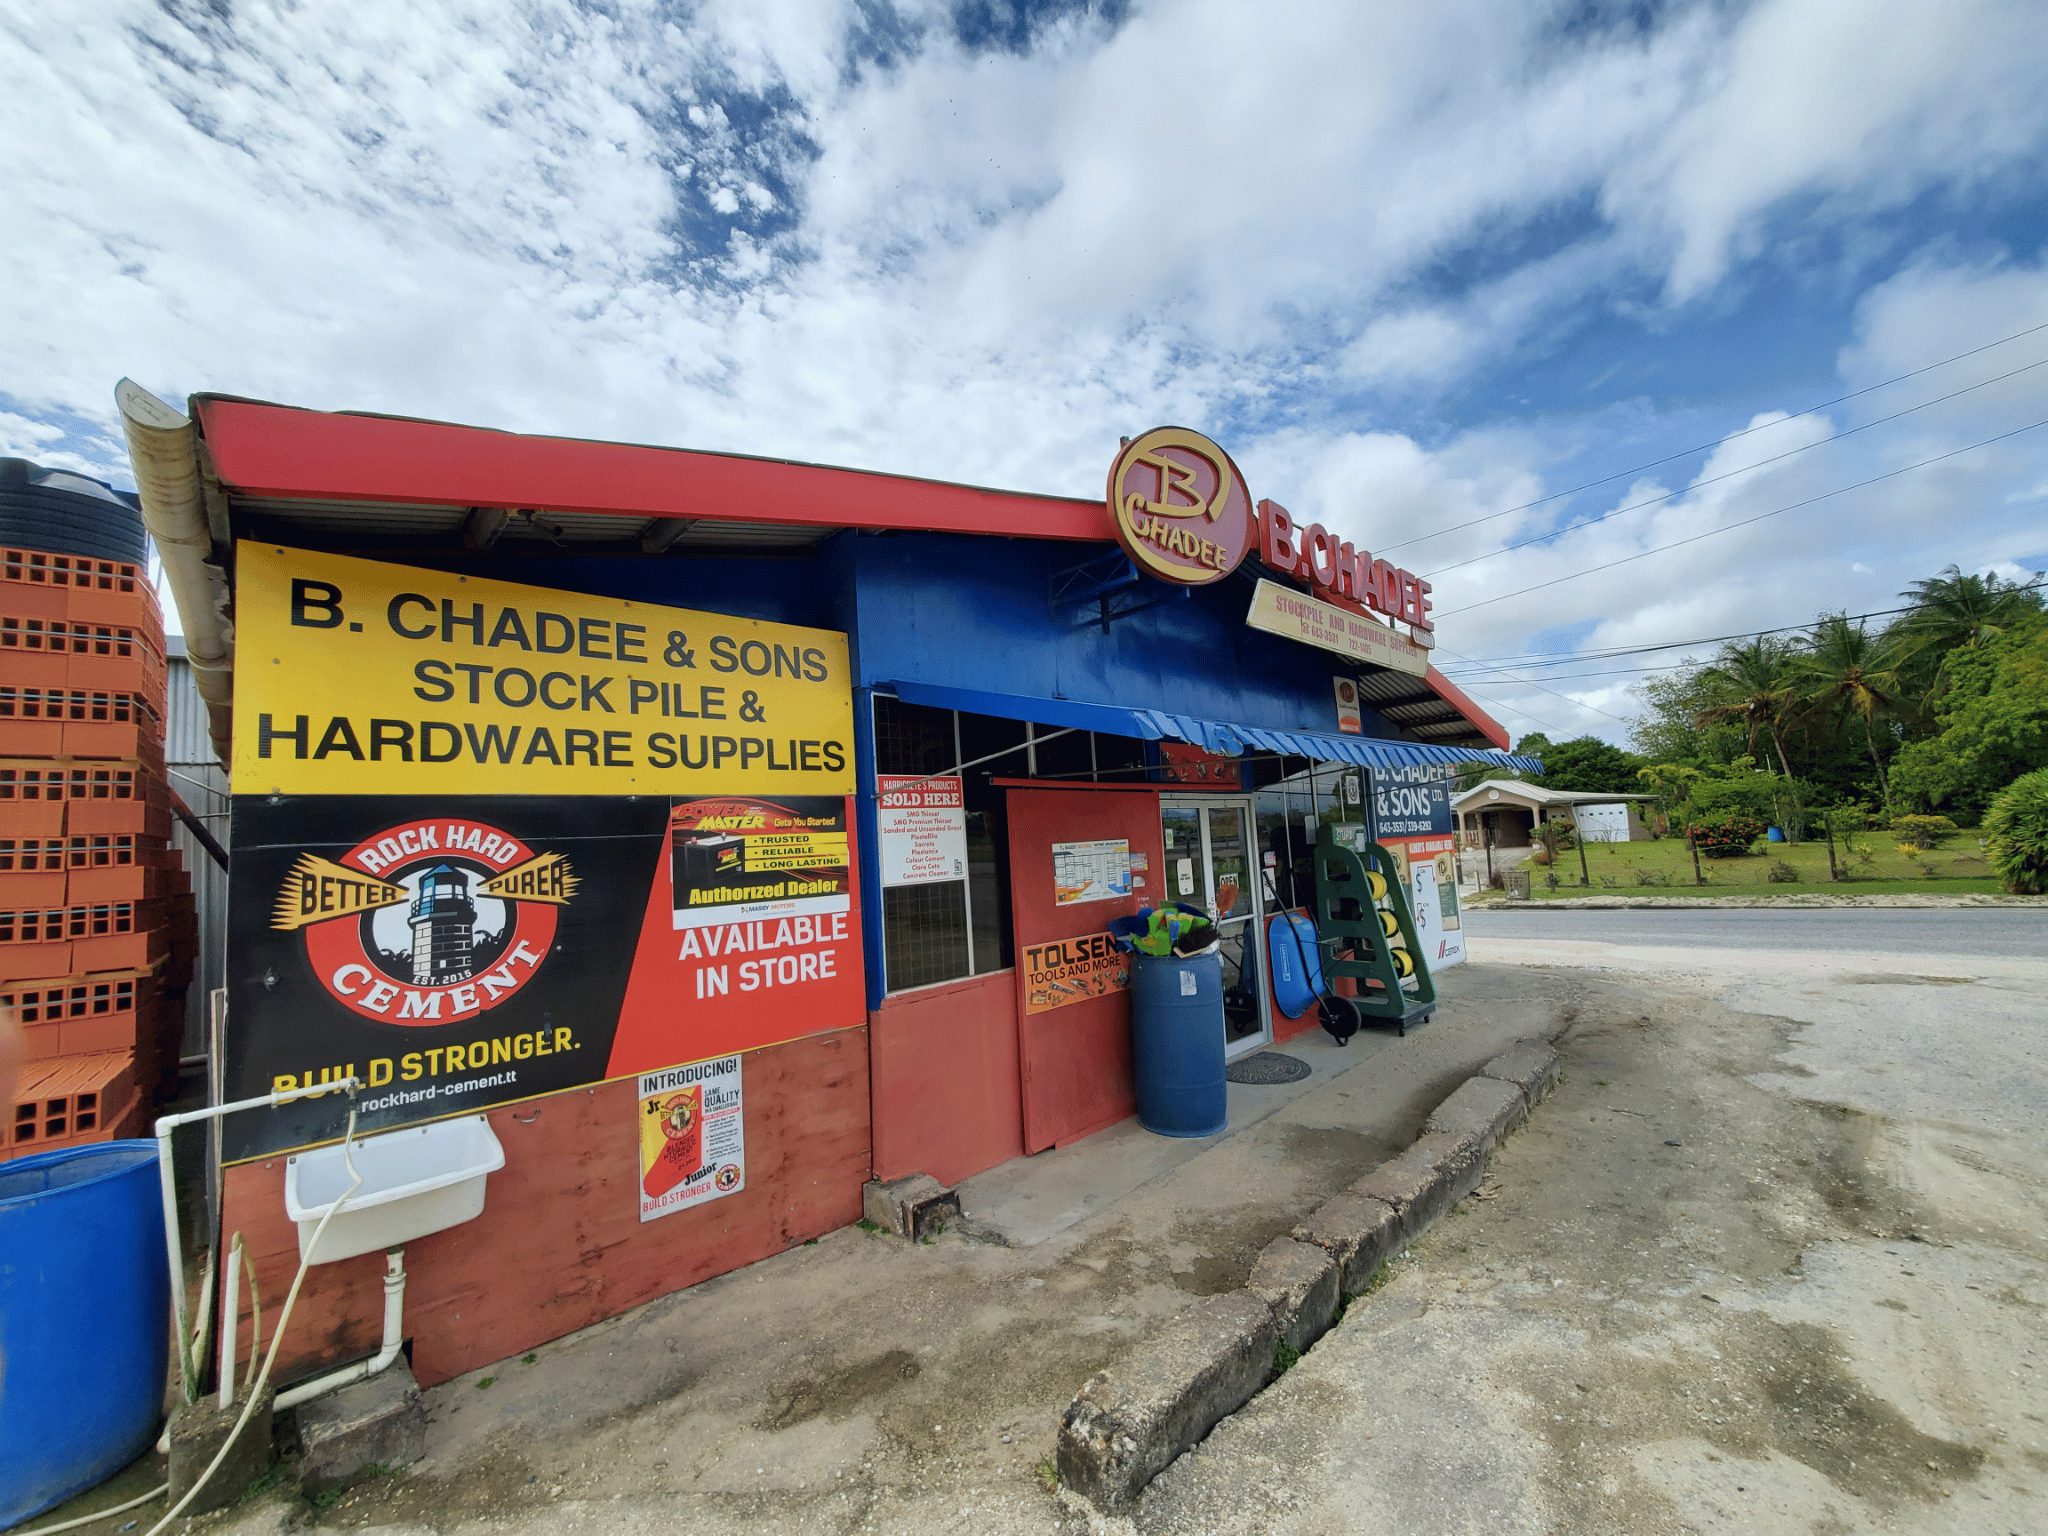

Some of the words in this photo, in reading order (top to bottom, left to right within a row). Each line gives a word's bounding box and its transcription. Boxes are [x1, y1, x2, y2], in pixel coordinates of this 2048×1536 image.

[1126, 492, 1229, 572] CHADEE
[290, 577, 364, 632] B.
[386, 591, 648, 664] CHADEE
[663, 630, 696, 670] &
[708, 635, 829, 683] SONS
[1276, 595, 1323, 625] STOCKPILE
[1329, 614, 1345, 632] AND
[1348, 620, 1387, 648] HARDWARE
[1390, 635, 1418, 658] SUPPLIES
[413, 659, 615, 714] STOCK
[629, 678, 728, 721] PILE
[738, 690, 767, 724] &
[257, 713, 635, 768] HARDWARE
[647, 731, 846, 773] SUPPLIES
[882, 793, 922, 806] SOLD
[924, 792, 960, 806] HERE
[928, 780, 957, 791] PRODUCTS
[678, 803, 748, 819] POWER
[1377, 786, 1391, 817] &
[1390, 786, 1431, 817] SONS
[693, 815, 767, 831] MASTER
[774, 818, 792, 828] Gets
[793, 816, 806, 826] You
[806, 816, 836, 826] Started!
[357, 824, 439, 874] ROCK
[445, 824, 519, 865] HARD
[759, 835, 810, 844] TRUSTED
[762, 846, 815, 856] RELIABLE
[763, 860, 794, 869] LONG
[796, 858, 841, 868] LASTING
[924, 855, 945, 863] Cement
[928, 870, 949, 878] Cleaner
[488, 860, 565, 897] PURER
[689, 882, 785, 905] Authorized
[788, 879, 839, 896] Dealer
[301, 872, 397, 916] BETTER
[748, 904, 770, 912] MASSY
[770, 902, 796, 911] MOTORS
[679, 912, 850, 961] AVAILABLE
[1027, 935, 1120, 972] TOLSEN
[332, 939, 540, 1019] CEMENT
[412, 974, 440, 986] EST.
[442, 969, 473, 984] 2015
[696, 964, 729, 1000] IN
[738, 951, 838, 993] STORE
[1029, 967, 1066, 985] TOOLS
[1067, 962, 1090, 977] AND
[1092, 955, 1121, 971] MORE
[273, 1057, 394, 1106] BUILD
[400, 1026, 581, 1081] STRONGER.
[643, 1058, 738, 1093] INTRODUCING!
[361, 1070, 517, 1113] rockhard-cement.tt
[704, 1087, 721, 1098] SAME
[704, 1089, 740, 1107] QUALITY
[647, 1100, 665, 1115] Jr.
[684, 1162, 717, 1186] Junior
[643, 1196, 668, 1213] BUILD
[669, 1182, 712, 1204] STRONGER
